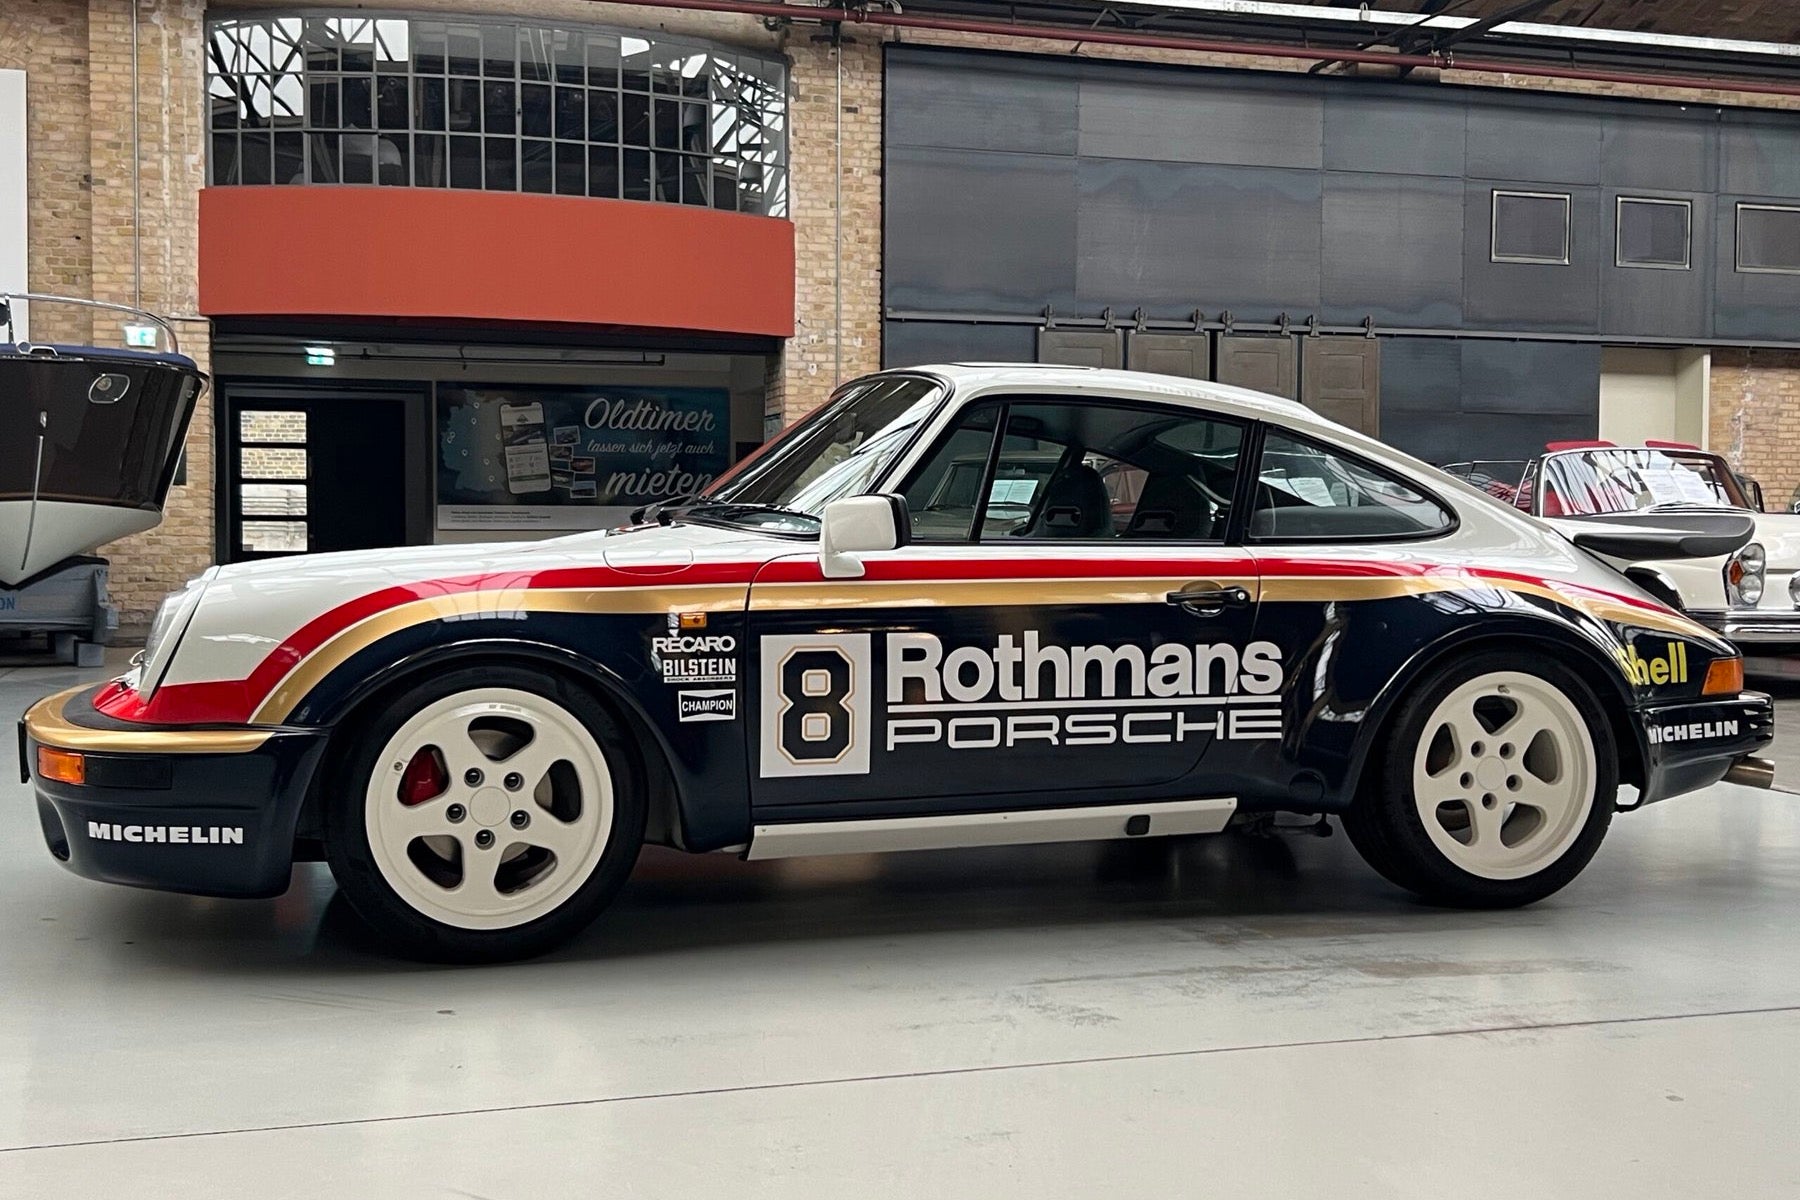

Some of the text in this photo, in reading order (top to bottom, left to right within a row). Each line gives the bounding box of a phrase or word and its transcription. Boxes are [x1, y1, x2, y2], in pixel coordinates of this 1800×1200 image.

[584, 397, 716, 432] Oldtimer
[587, 439, 714, 460] lassen sich jetzt auch
[652, 635, 736, 653] RECARO
[663, 658, 736, 676] BILSTEIN
[886, 630, 1283, 703] Rothmans
[682, 699, 733, 712] CHAMPION
[778, 645, 855, 765] 8
[886, 709, 1283, 751] PORSCHE
[88, 821, 244, 844] MICHELIN
